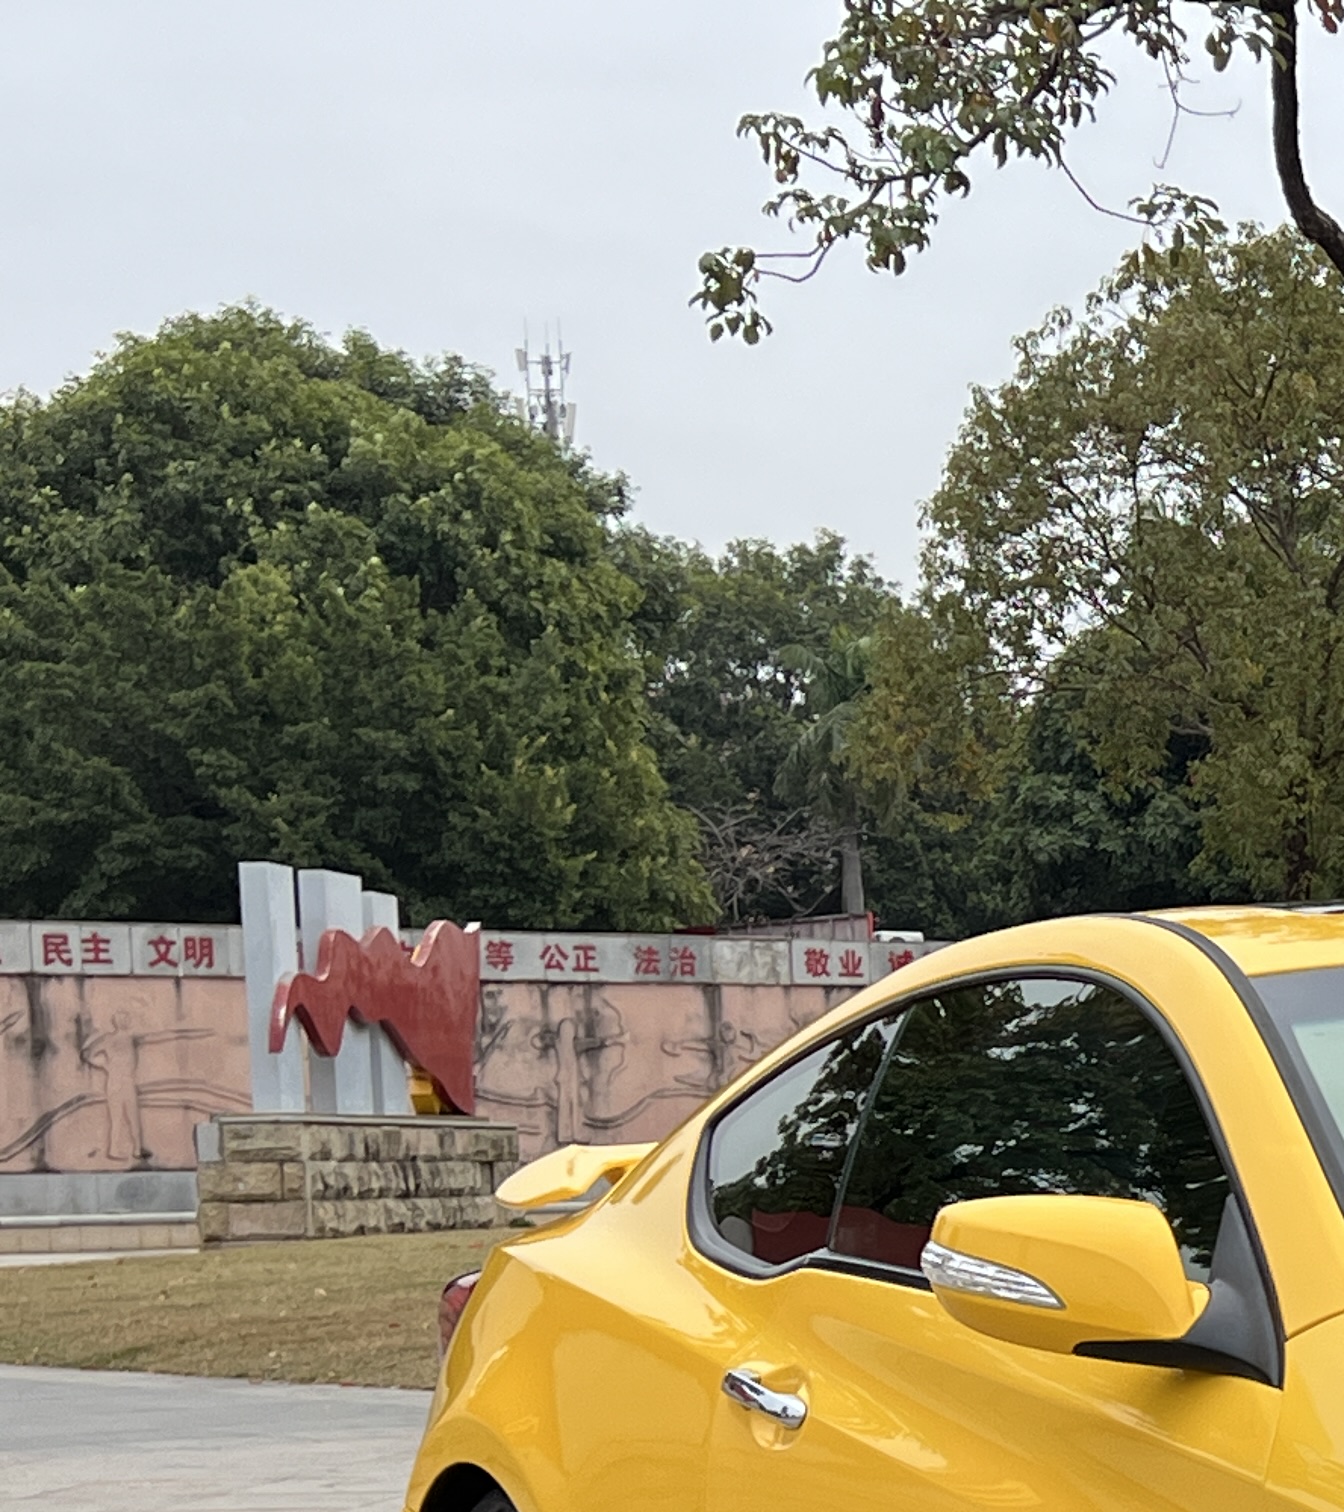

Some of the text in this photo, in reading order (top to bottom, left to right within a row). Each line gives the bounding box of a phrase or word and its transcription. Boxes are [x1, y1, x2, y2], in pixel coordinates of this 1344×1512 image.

[42, 932, 113, 966] 民主
[147, 935, 214, 968] 文明
[486, 940, 514, 972] 等
[539, 944, 599, 972] 公正
[633, 945, 697, 976] 法治
[804, 948, 864, 978] 敬业
